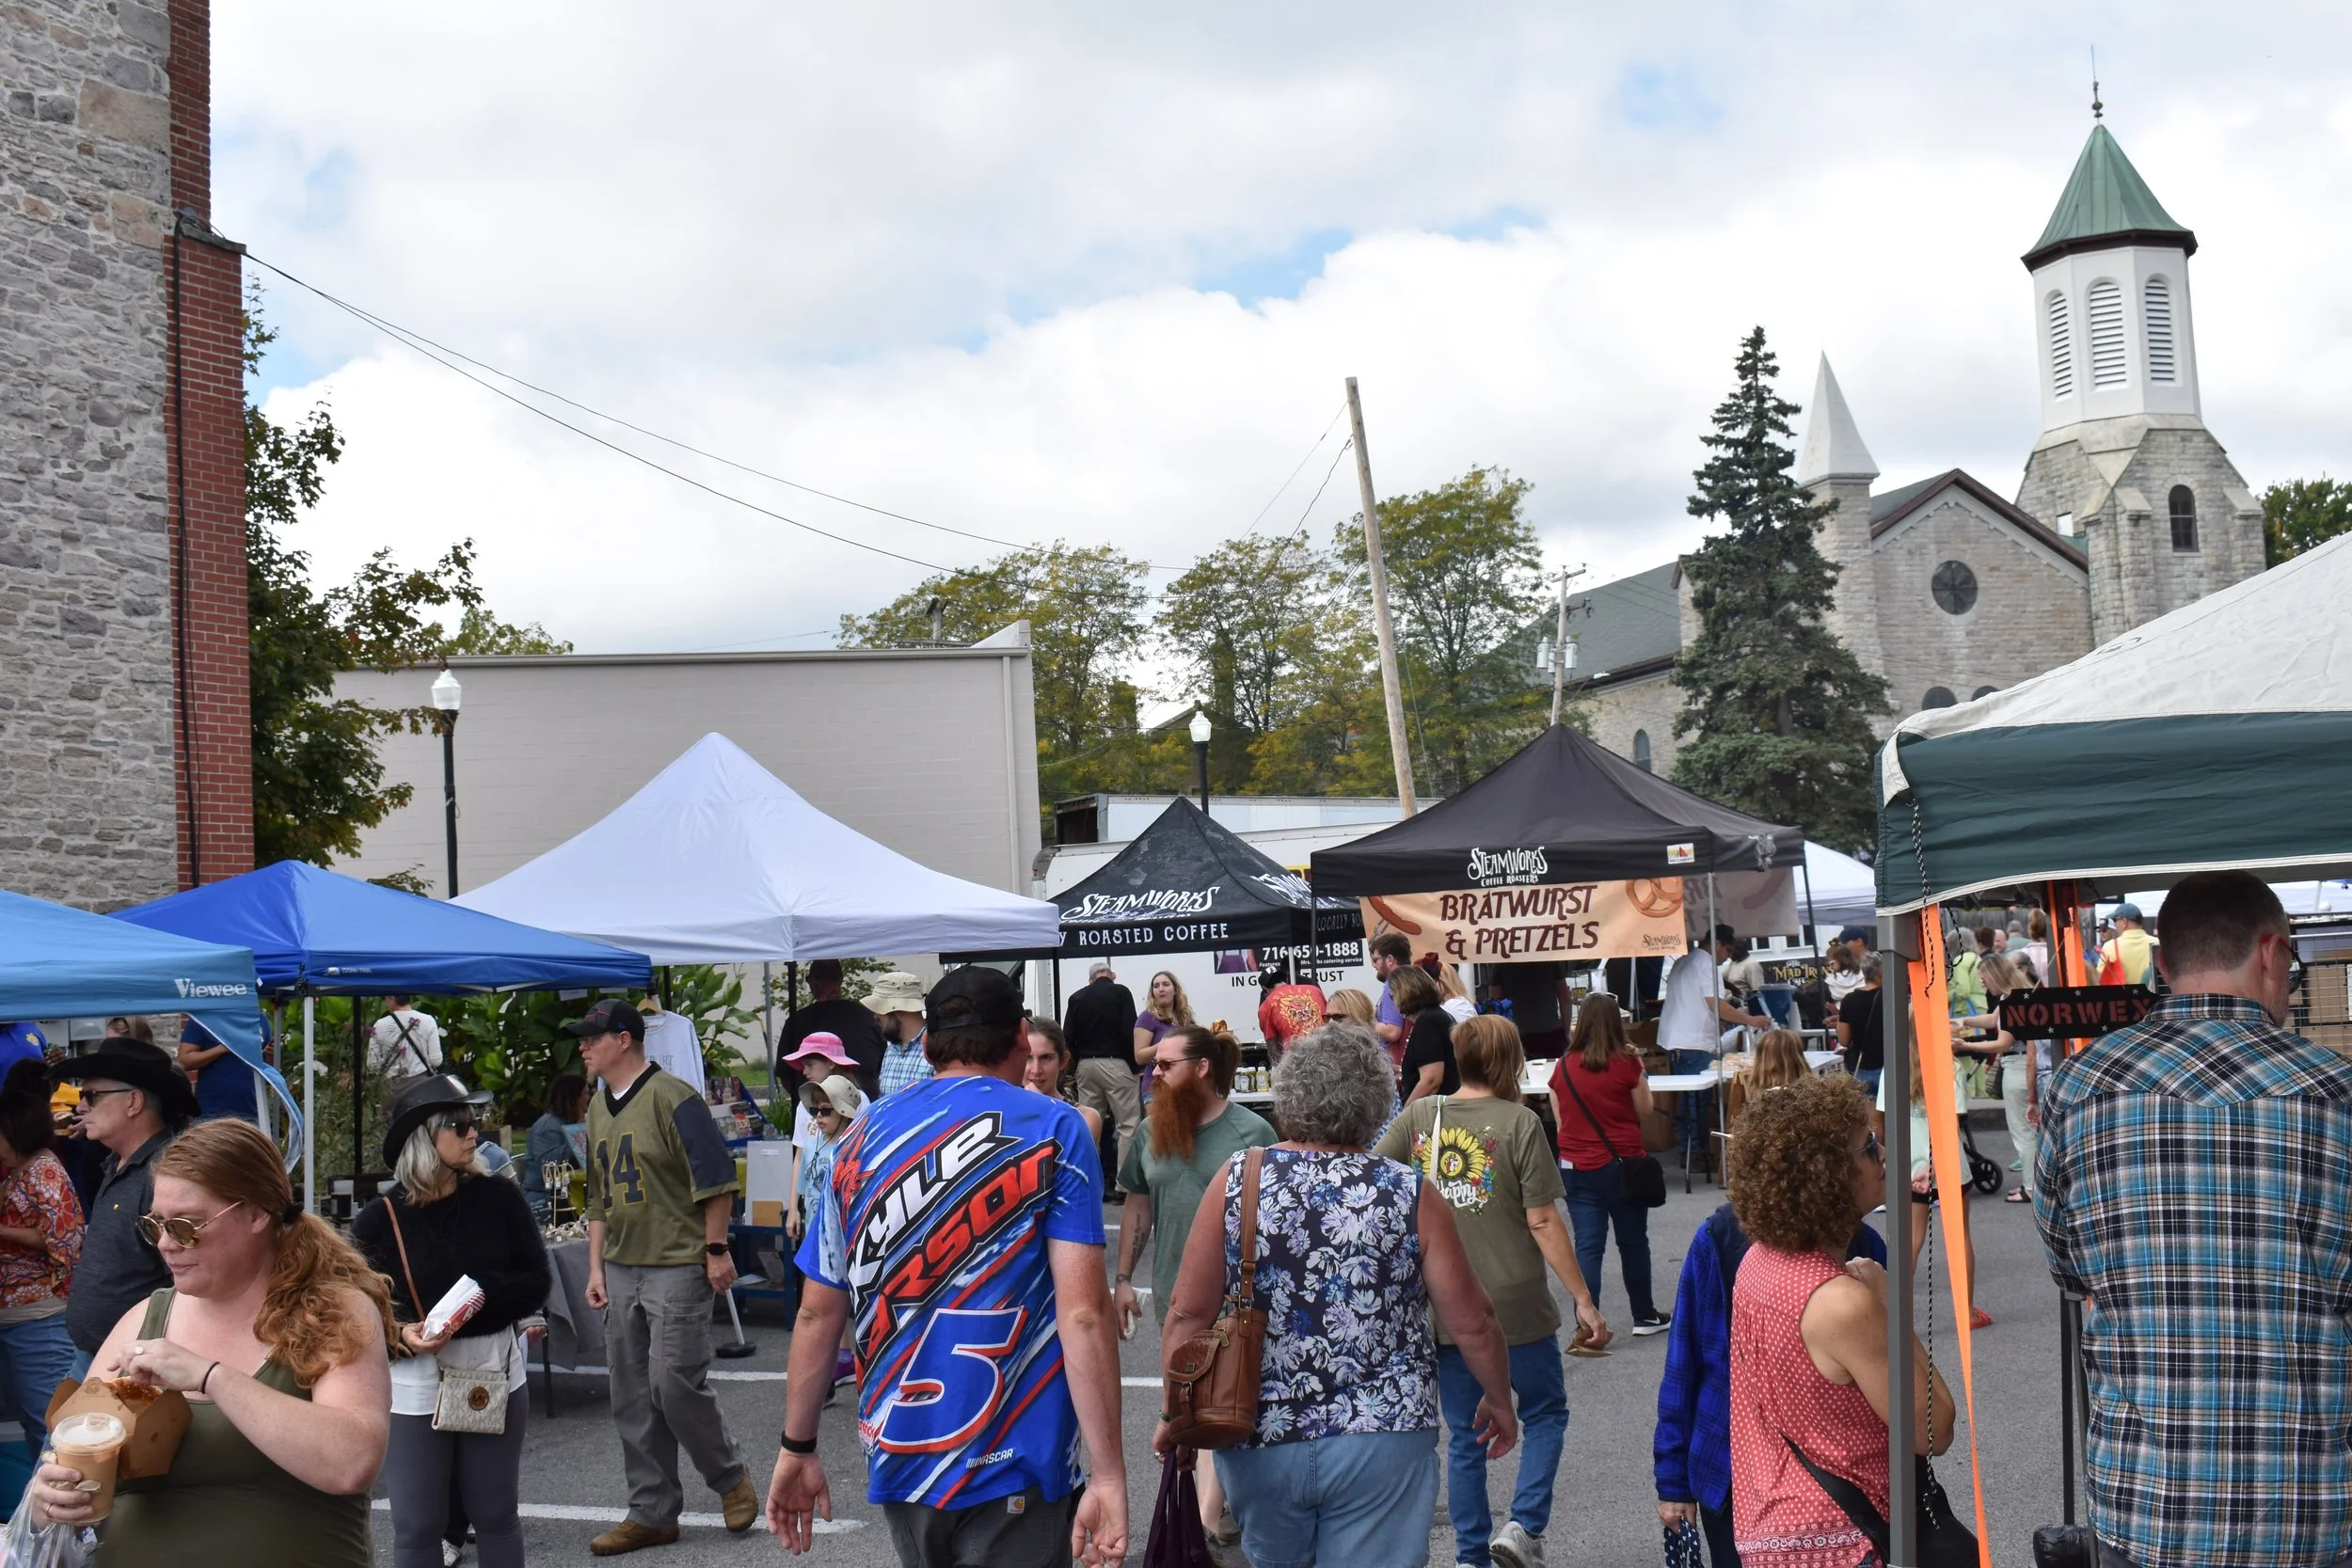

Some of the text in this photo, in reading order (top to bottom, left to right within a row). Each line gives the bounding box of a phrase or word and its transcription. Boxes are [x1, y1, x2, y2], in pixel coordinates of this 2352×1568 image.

[1481, 873, 1539, 888] COFFEE ROASTERS
[1439, 885, 1598, 926] BRATWURST
[1079, 927, 1153, 946] ROASTED
[1164, 923, 1229, 942] COFFEE
[1445, 921, 1599, 961] & PRETZELS
[1232, 976, 1244, 988] IN
[1801, 963, 1834, 978] IRNS
[174, 978, 247, 998] Viewee
[2006, 999, 2152, 1027] NORWEX
[596, 1132, 646, 1212] 14
[856, 1146, 1054, 1364] ARSON
[878, 1305, 1029, 1453] 5
[973, 1448, 1014, 1466] NASCAR
